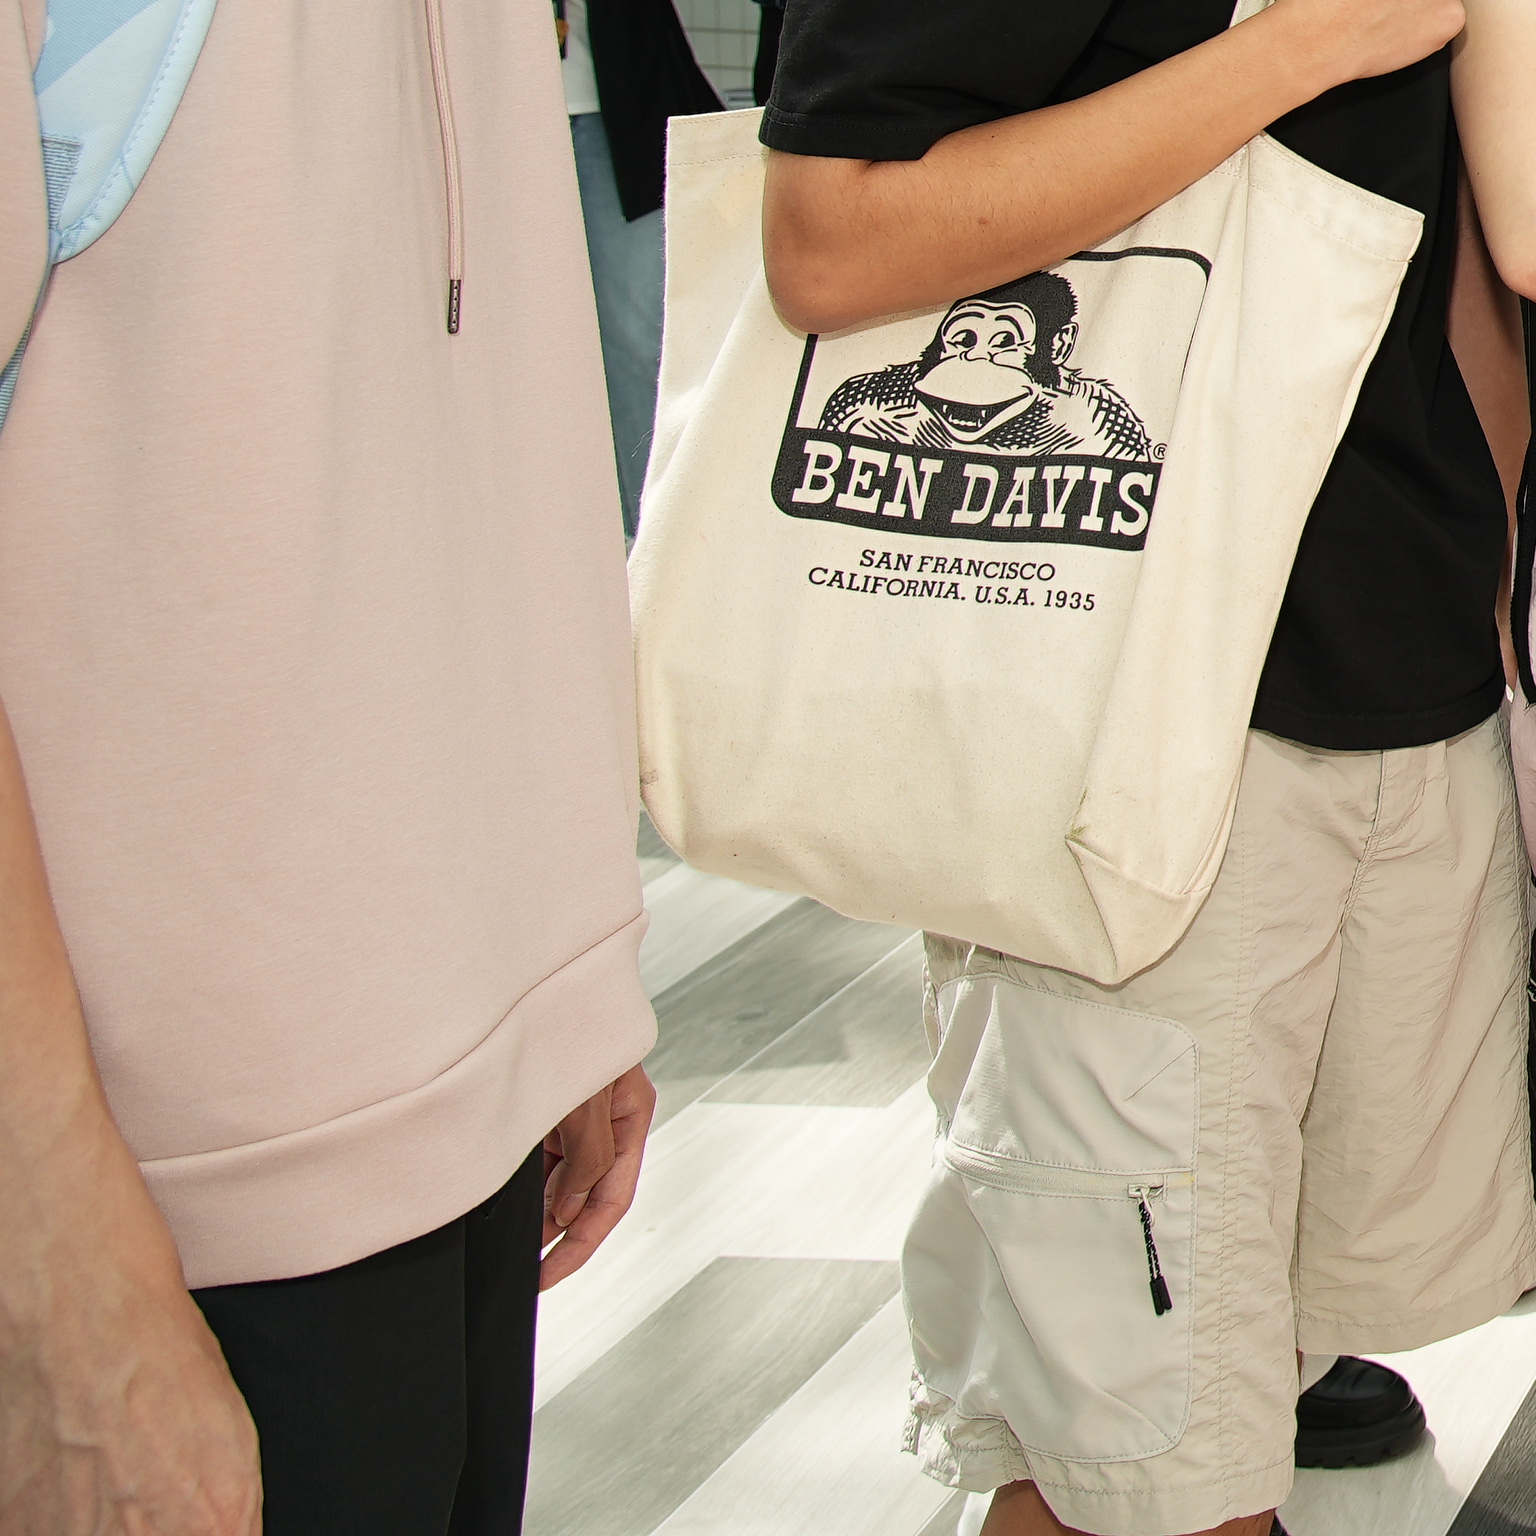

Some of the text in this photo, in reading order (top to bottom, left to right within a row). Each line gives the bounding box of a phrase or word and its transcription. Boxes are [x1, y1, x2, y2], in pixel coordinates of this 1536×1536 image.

[791, 439, 1155, 537] BEN DAVIS
[859, 548, 1056, 583] SAN FRANCISCO
[807, 566, 1096, 612] CALIFORNIA. U.S.A. 1935
